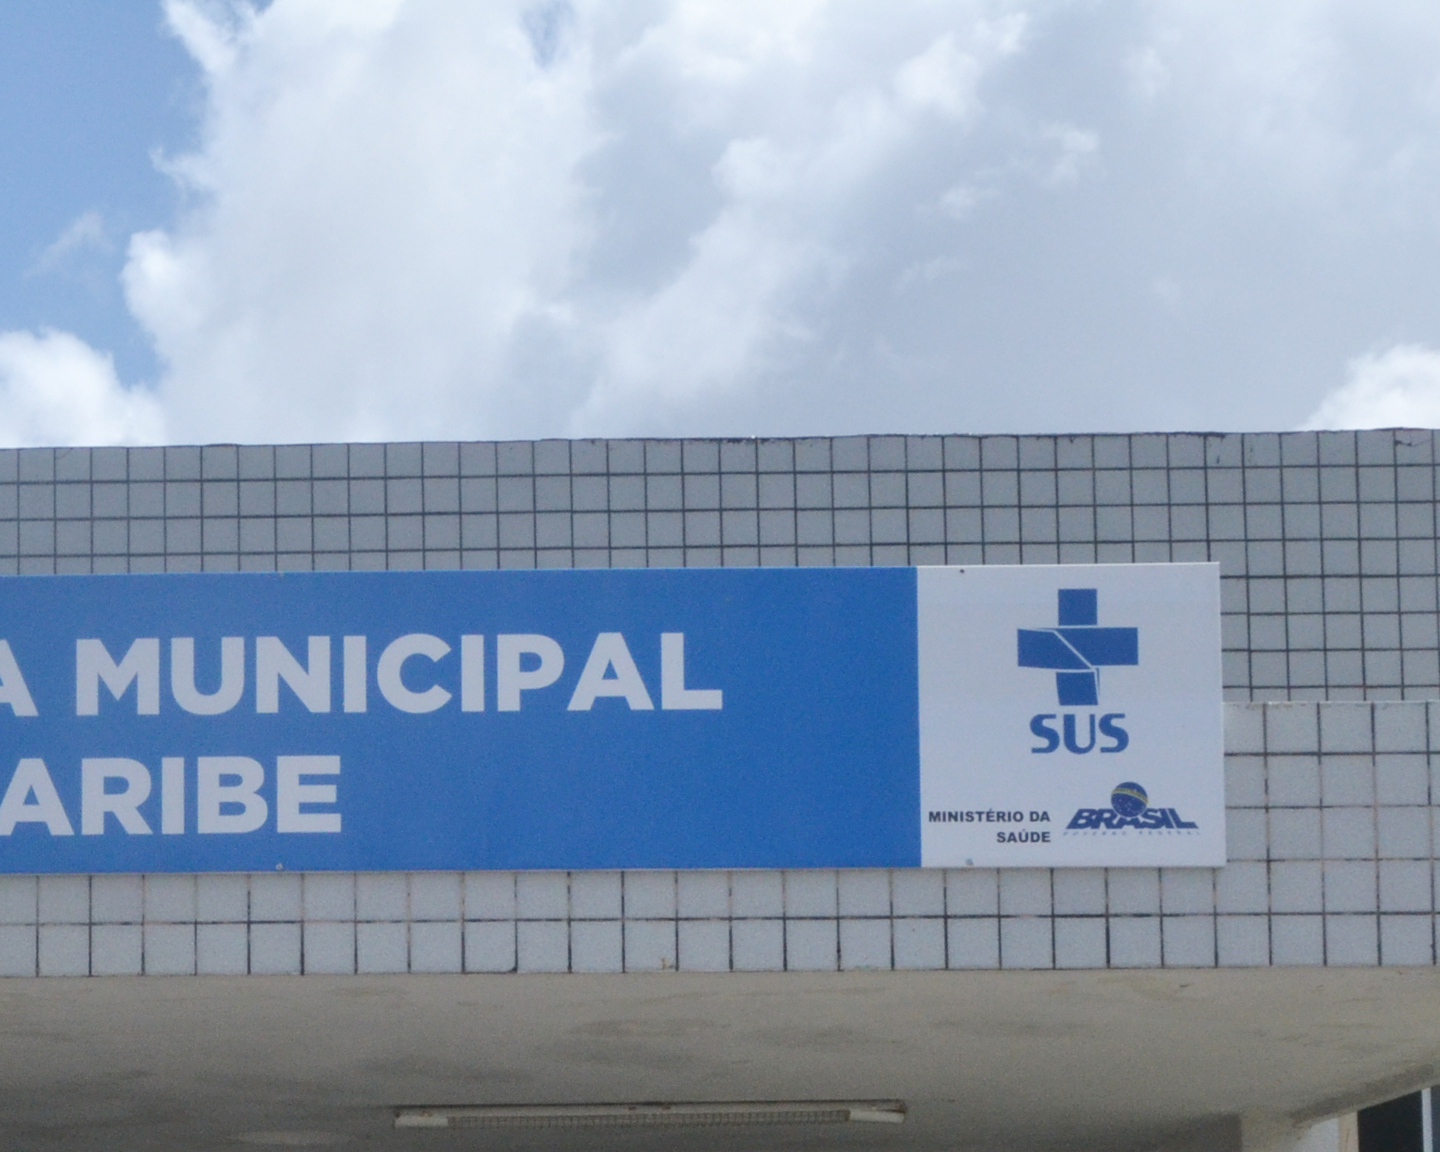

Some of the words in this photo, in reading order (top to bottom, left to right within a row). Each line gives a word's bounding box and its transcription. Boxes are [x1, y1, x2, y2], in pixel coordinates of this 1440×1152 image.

[74, 632, 724, 717] MUNICIPAL
[1030, 713, 1129, 754] SUS
[928, 808, 1024, 823] MINISTÉRIO
[1029, 811, 1050, 823] DA
[1065, 807, 1199, 830] BRASIL
[996, 829, 1051, 844] SAÚDE
